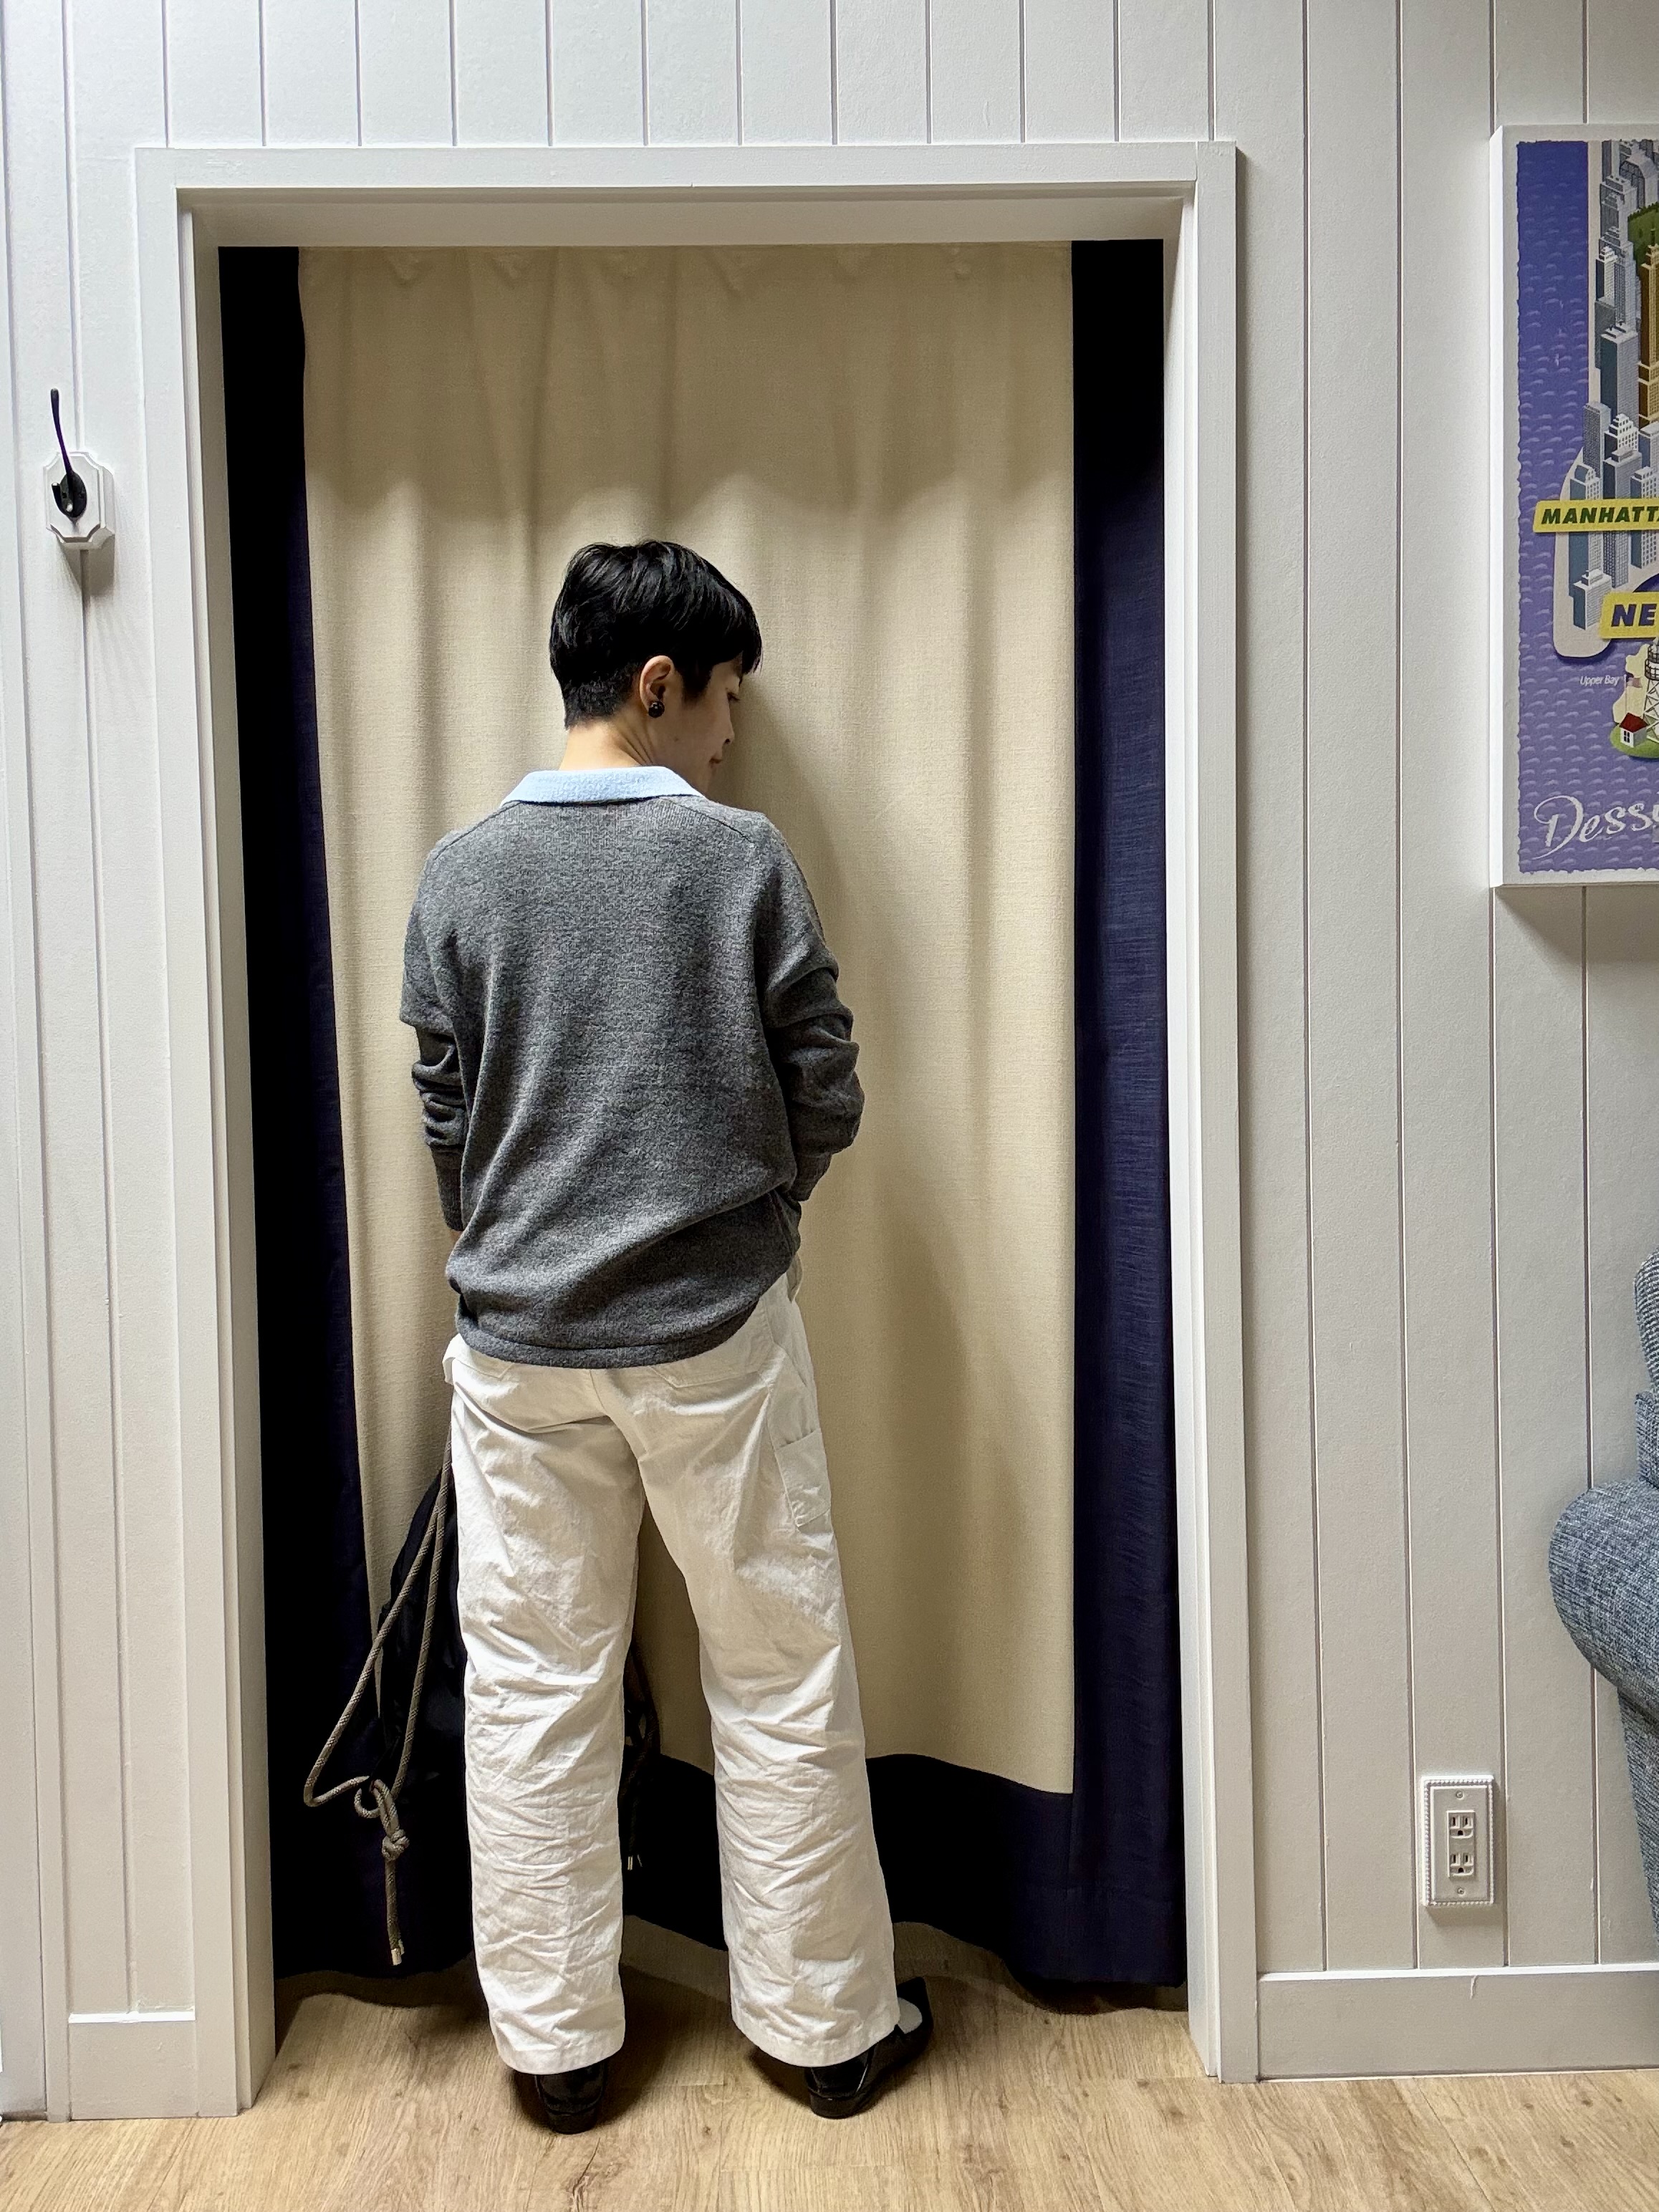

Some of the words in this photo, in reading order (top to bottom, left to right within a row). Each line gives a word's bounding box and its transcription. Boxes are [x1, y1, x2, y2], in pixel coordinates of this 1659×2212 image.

[1541, 506, 1659, 524] MANHATT
[1579, 675, 1604, 687] Upper
[1604, 675, 1620, 687] Bay
